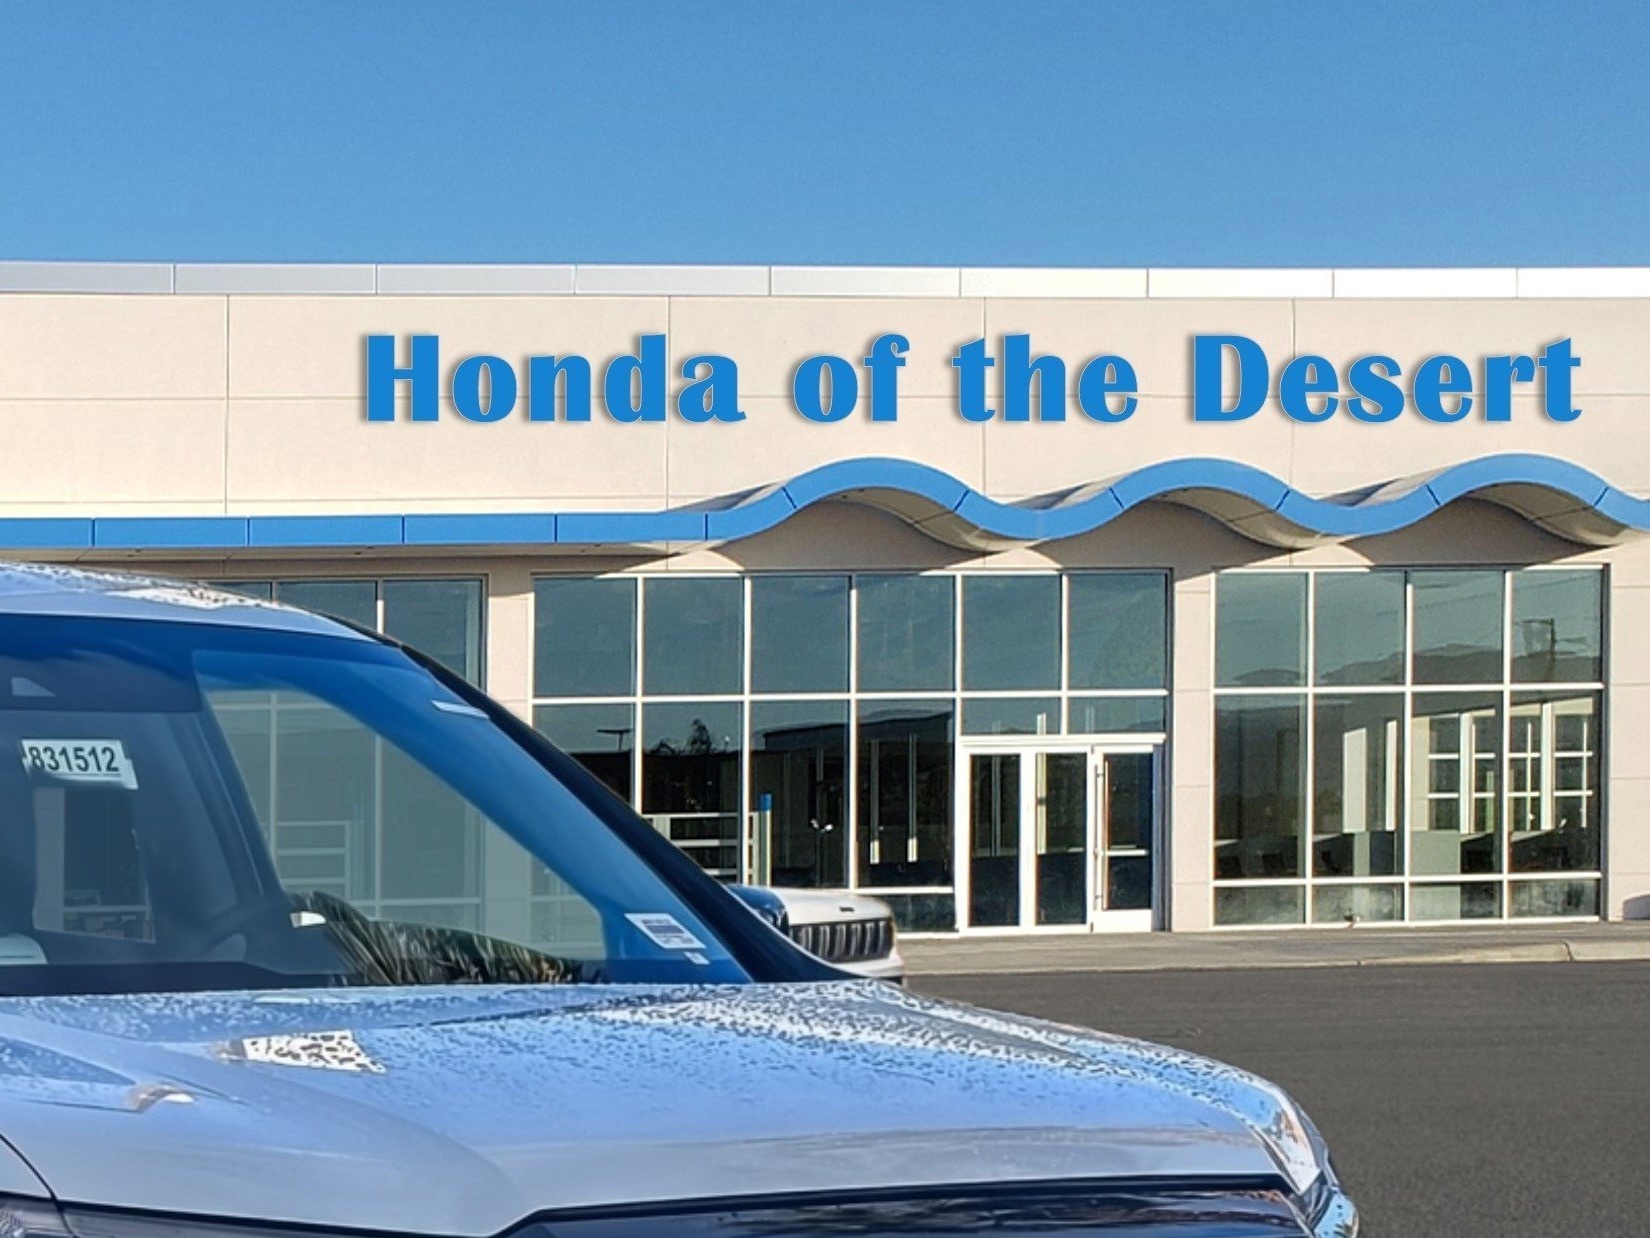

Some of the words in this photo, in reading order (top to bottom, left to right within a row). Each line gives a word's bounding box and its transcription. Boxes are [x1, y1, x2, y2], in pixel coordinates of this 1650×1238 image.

[365, 333, 747, 424] Honda
[792, 333, 910, 424] of
[951, 333, 1139, 424] the
[1192, 334, 1583, 424] Desert
[28, 746, 118, 772] 831512
